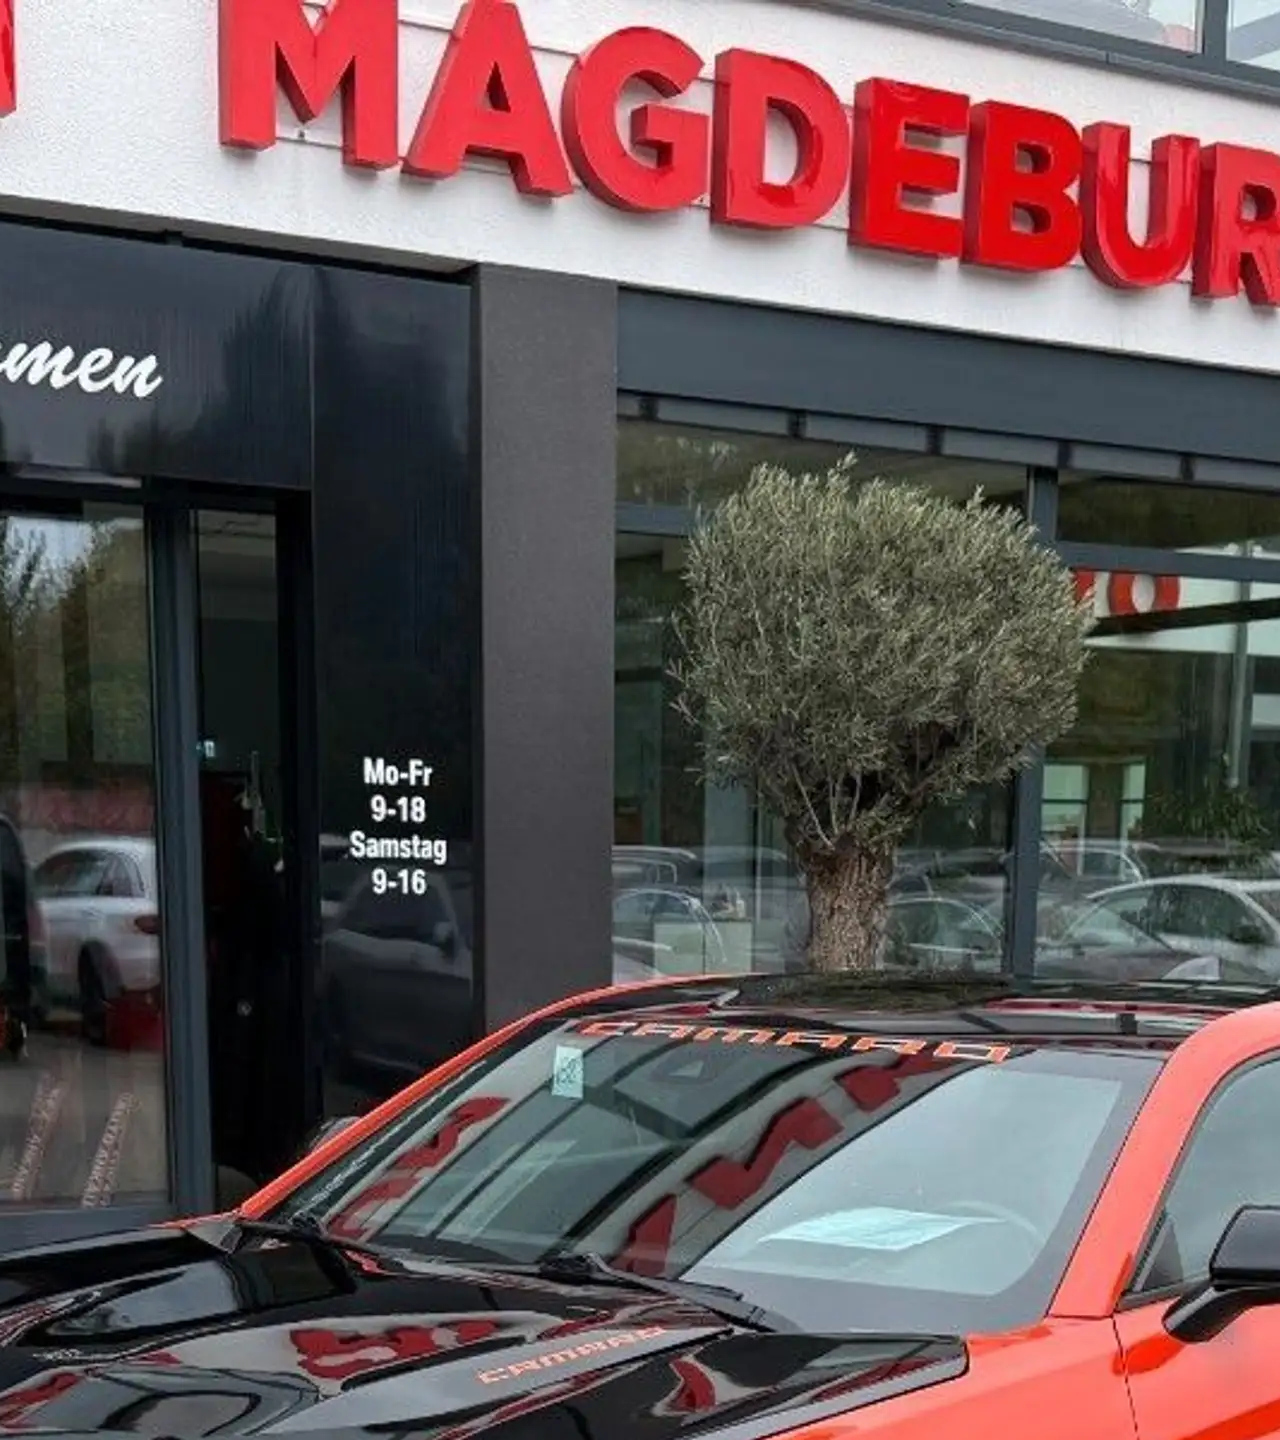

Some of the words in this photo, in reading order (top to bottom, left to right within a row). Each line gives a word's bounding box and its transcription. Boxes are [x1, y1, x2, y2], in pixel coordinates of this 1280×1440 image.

[363, 757, 433, 786] Mo-Fr
[370, 794, 426, 823] 9-18
[349, 830, 447, 866] Samstag
[372, 868, 426, 895] 9-16
[578, 1021, 1011, 1063] CAMARO
